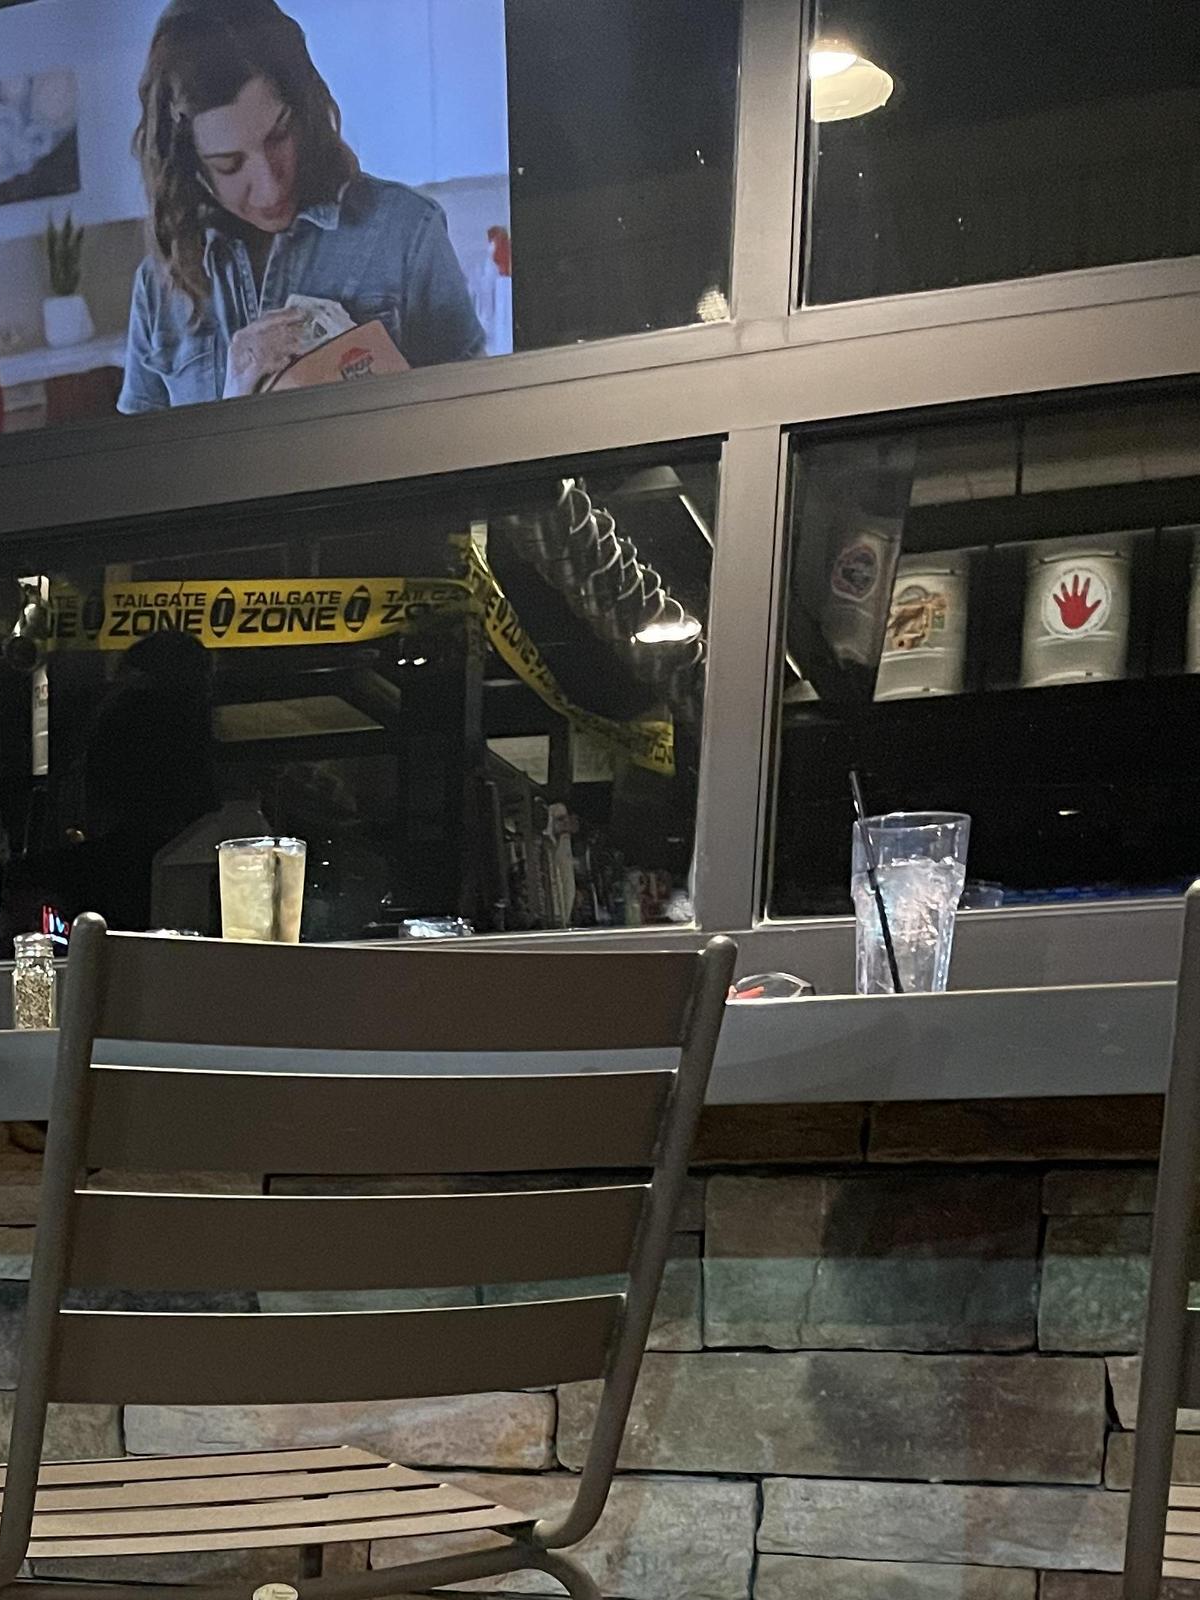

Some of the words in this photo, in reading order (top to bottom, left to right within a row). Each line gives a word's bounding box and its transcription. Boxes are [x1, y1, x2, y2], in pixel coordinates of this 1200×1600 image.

[113, 592, 207, 608] TAILGATE
[243, 590, 342, 606] TAILGATE
[108, 608, 205, 637] ZONE
[237, 606, 339, 634] ZONE
